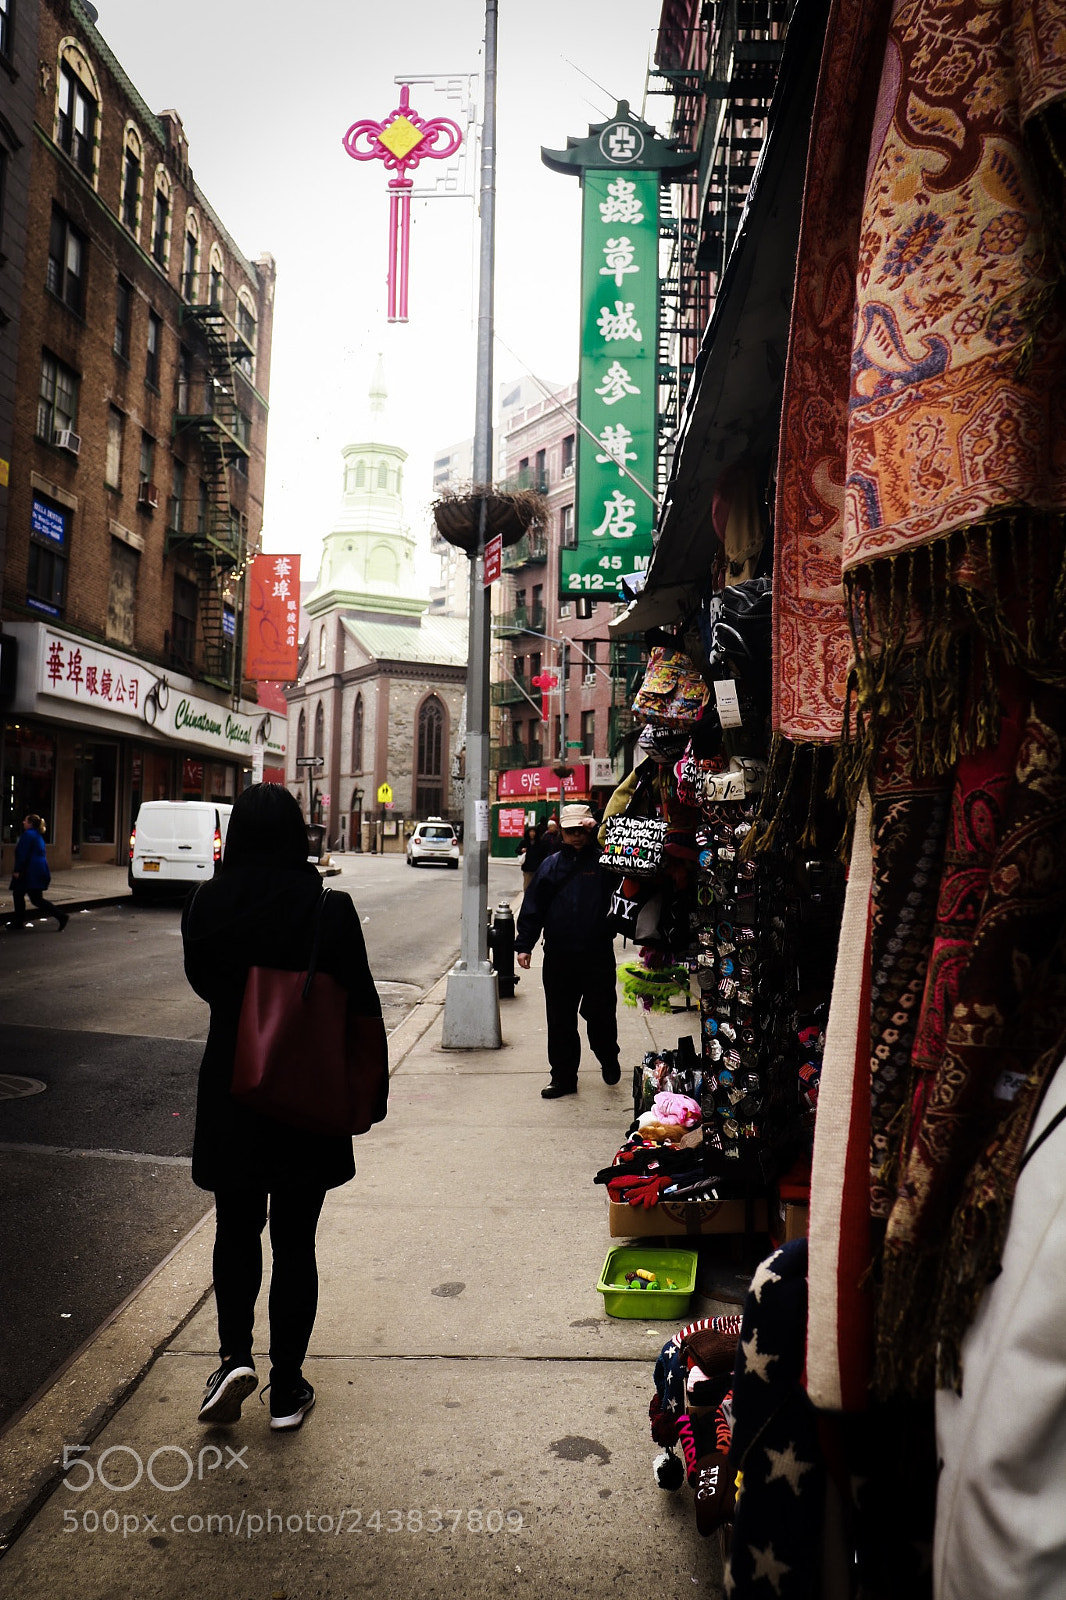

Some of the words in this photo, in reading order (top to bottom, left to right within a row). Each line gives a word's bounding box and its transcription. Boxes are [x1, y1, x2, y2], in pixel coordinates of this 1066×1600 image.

[599, 555, 622, 569] 45
[272, 556, 292, 602] 華埠
[46, 641, 139, 709] 華埠眼鏡公司
[174, 699, 222, 736] Chinatown
[225, 714, 252, 746] Optical
[602, 844, 622, 855] NEW
[622, 845, 647, 859] YORK
[612, 856, 632, 867] NEW
